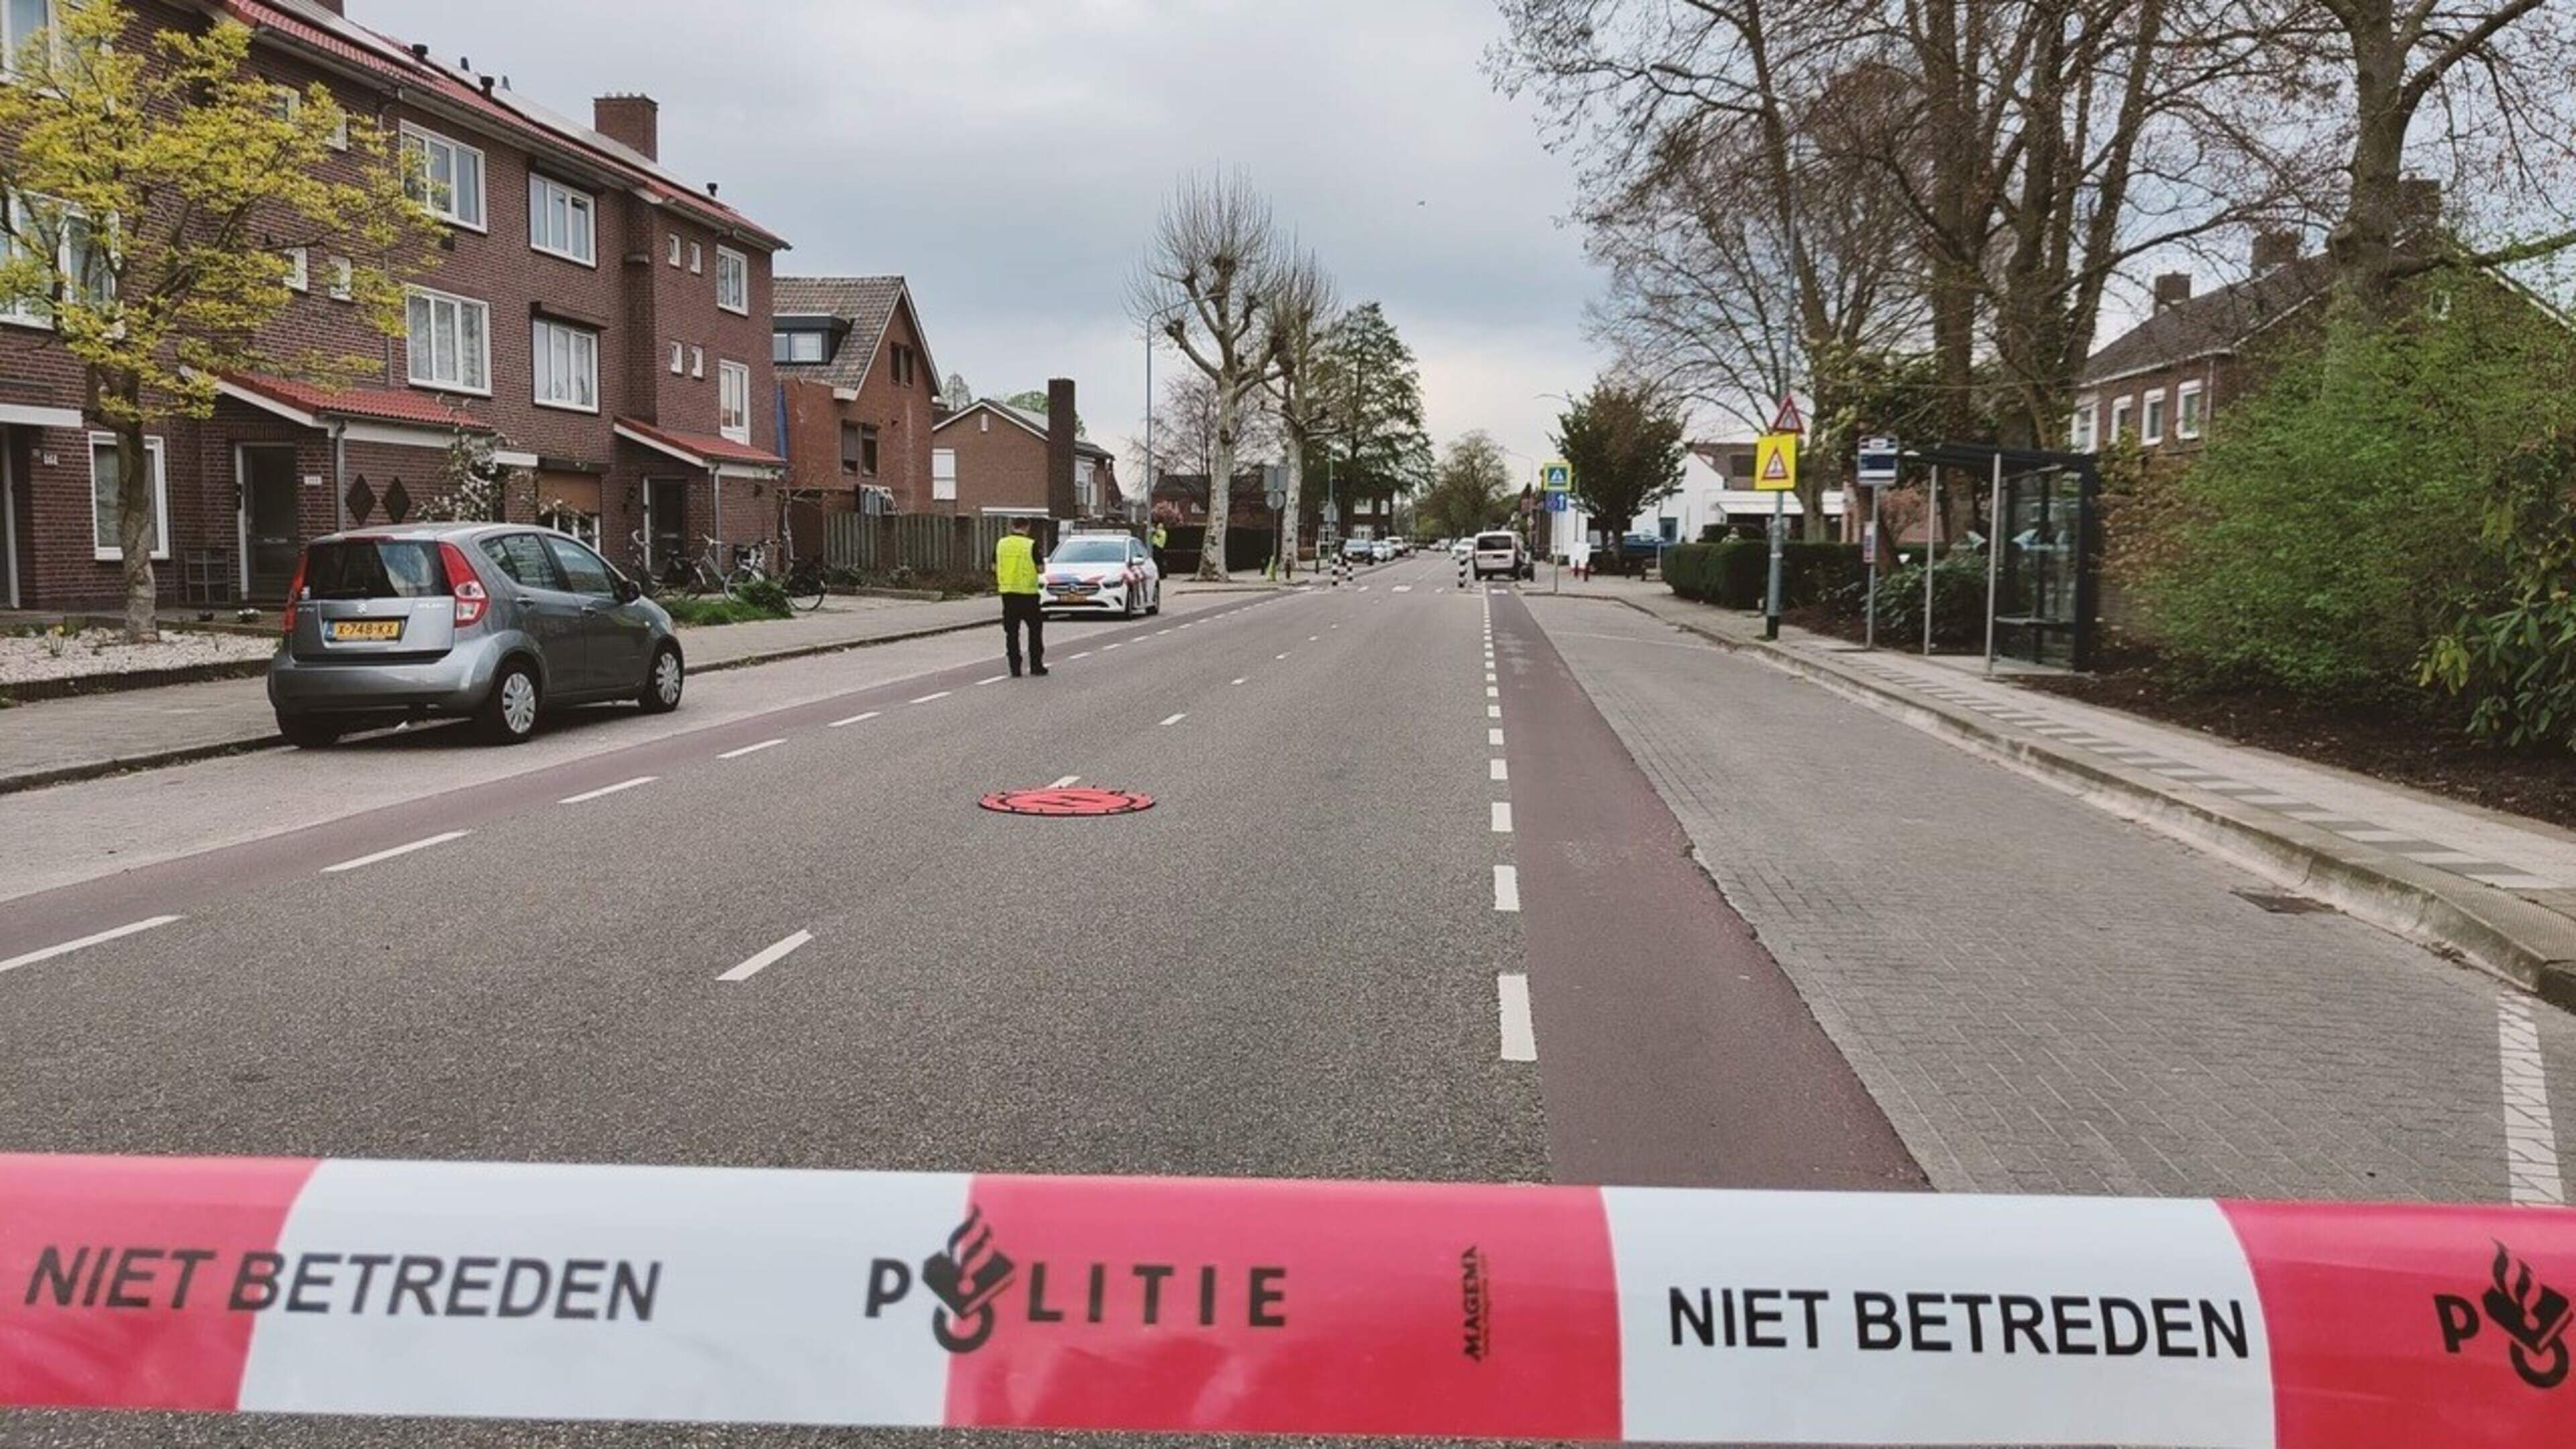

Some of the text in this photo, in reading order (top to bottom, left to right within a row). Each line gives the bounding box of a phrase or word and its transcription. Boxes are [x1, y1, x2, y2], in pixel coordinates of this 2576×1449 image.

[25, 1246, 661, 1322] NIET BETREDEN
[1668, 1286, 2250, 1359] NIET BETREDEN
